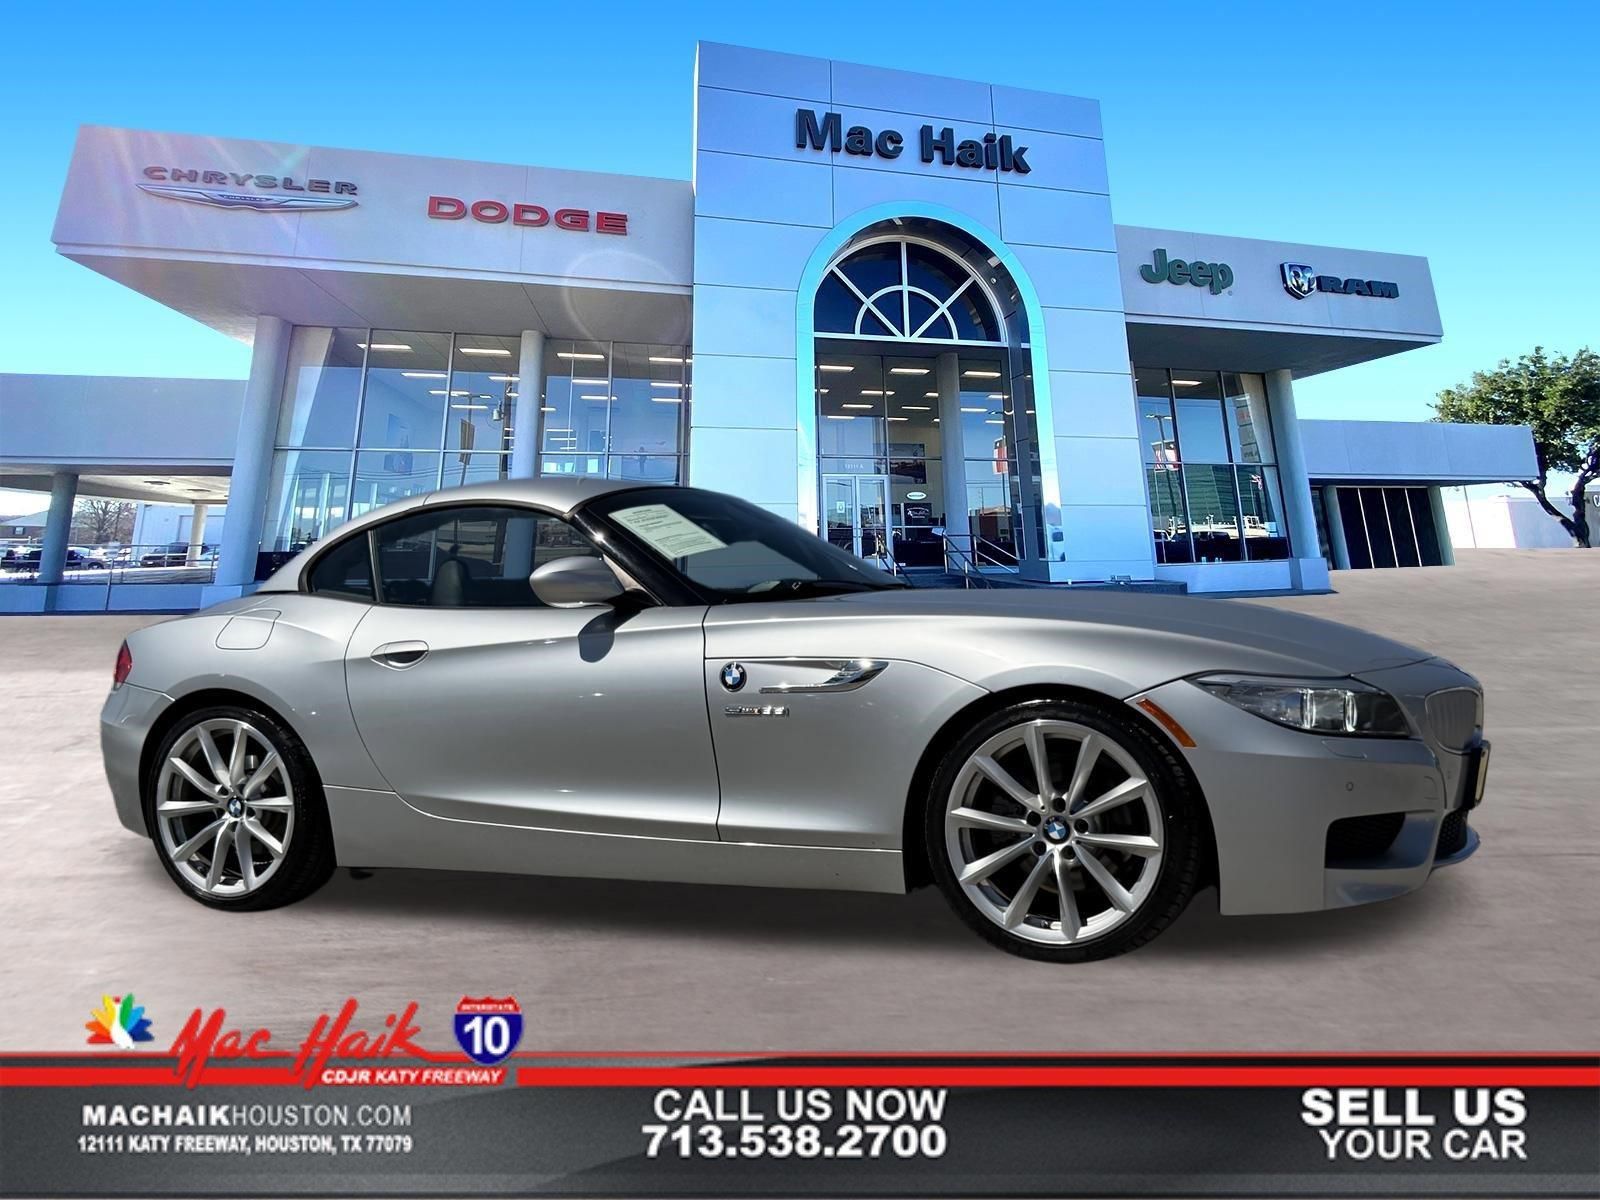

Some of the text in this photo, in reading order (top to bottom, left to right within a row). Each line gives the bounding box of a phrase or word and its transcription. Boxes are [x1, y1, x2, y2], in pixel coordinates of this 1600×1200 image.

[796, 108, 1032, 174] Mac Haik
[143, 166, 359, 196] CHRYSLER
[428, 196, 628, 236] DODGE
[1139, 248, 1234, 295] Jeep
[1316, 275, 1400, 299] RAM
